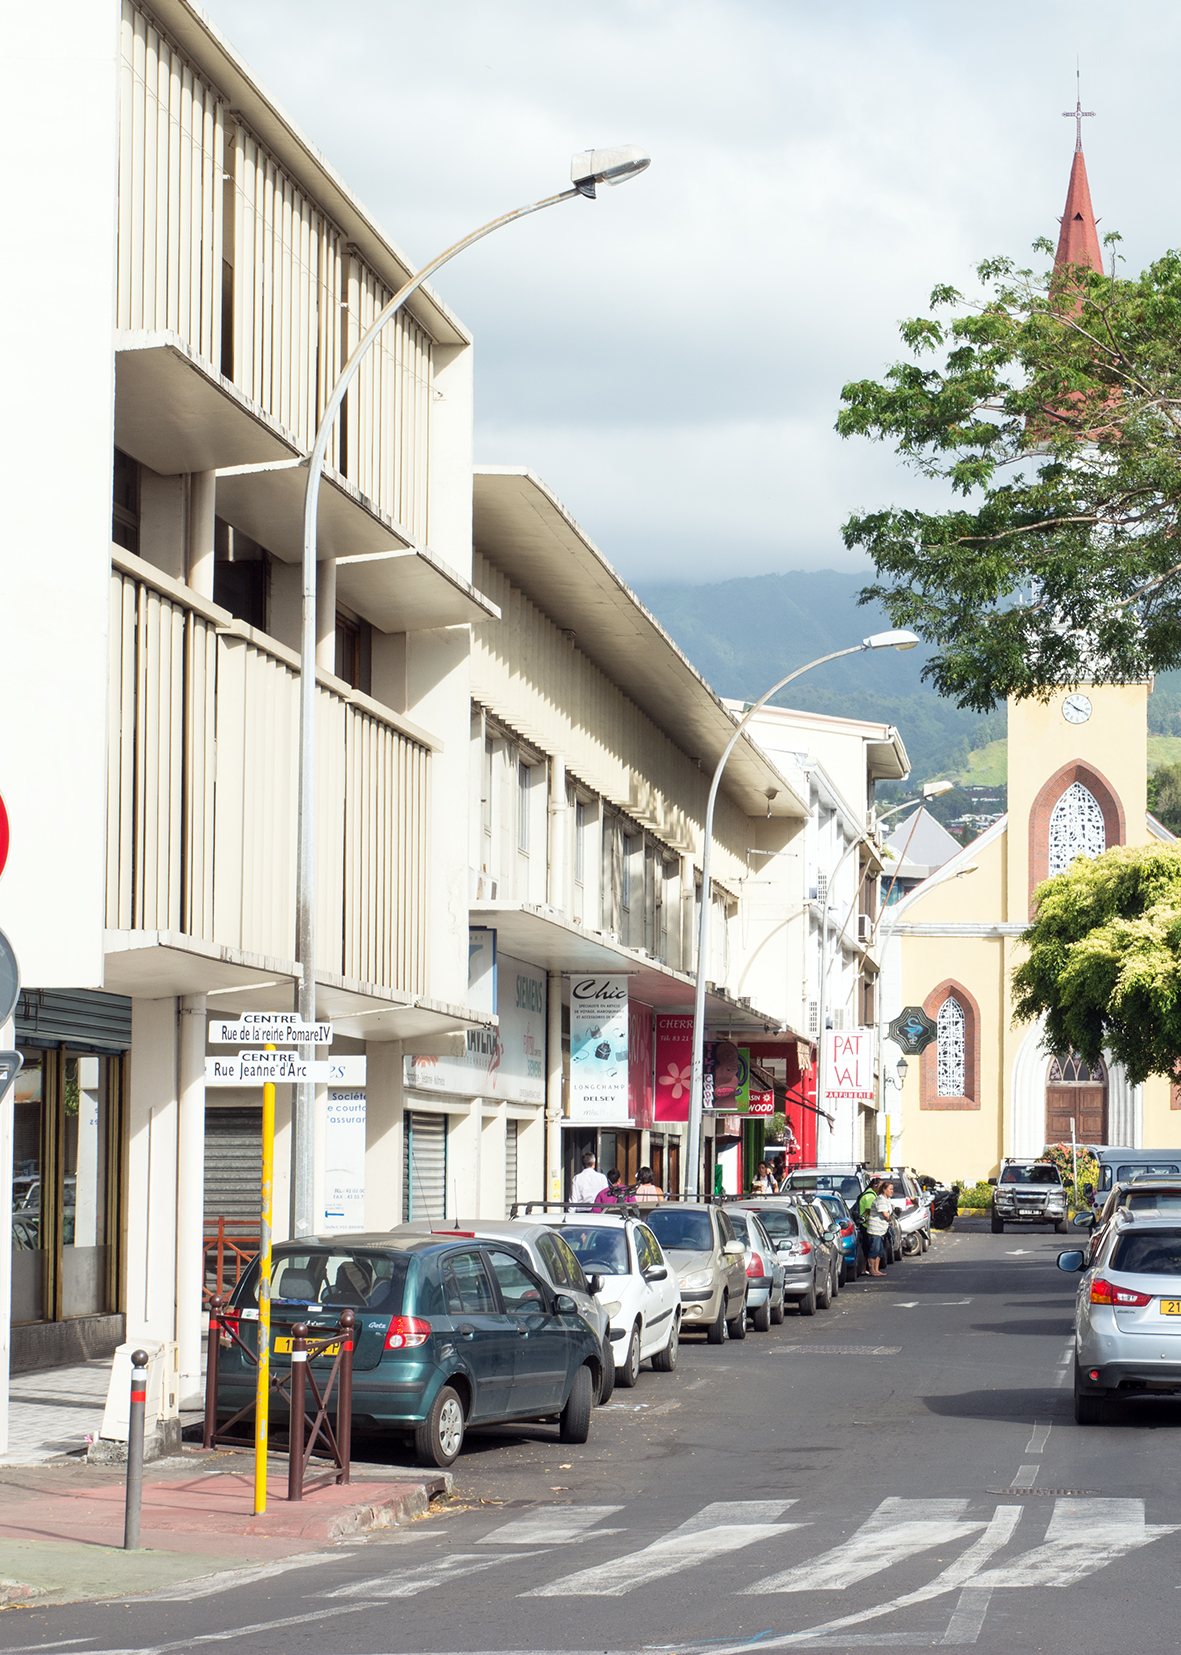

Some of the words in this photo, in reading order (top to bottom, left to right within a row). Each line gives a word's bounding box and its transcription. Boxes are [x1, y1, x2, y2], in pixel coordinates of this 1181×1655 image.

[516, 974, 543, 1014] SIEMENS
[572, 979, 627, 1000] Chic
[244, 1015, 297, 1023] CENTRE
[222, 1025, 238, 1041] Rue
[240, 1025, 250, 1041] de
[252, 1025, 260, 1041] la
[262, 1026, 284, 1041] reine
[242, 1053, 295, 1062] CENTRE
[834, 1035, 863, 1063] PAT
[214, 1062, 235, 1077] Rue
[239, 1062, 276, 1080] Jeanne
[279, 1062, 307, 1077] d'Arc
[834, 1059, 862, 1087] VAL
